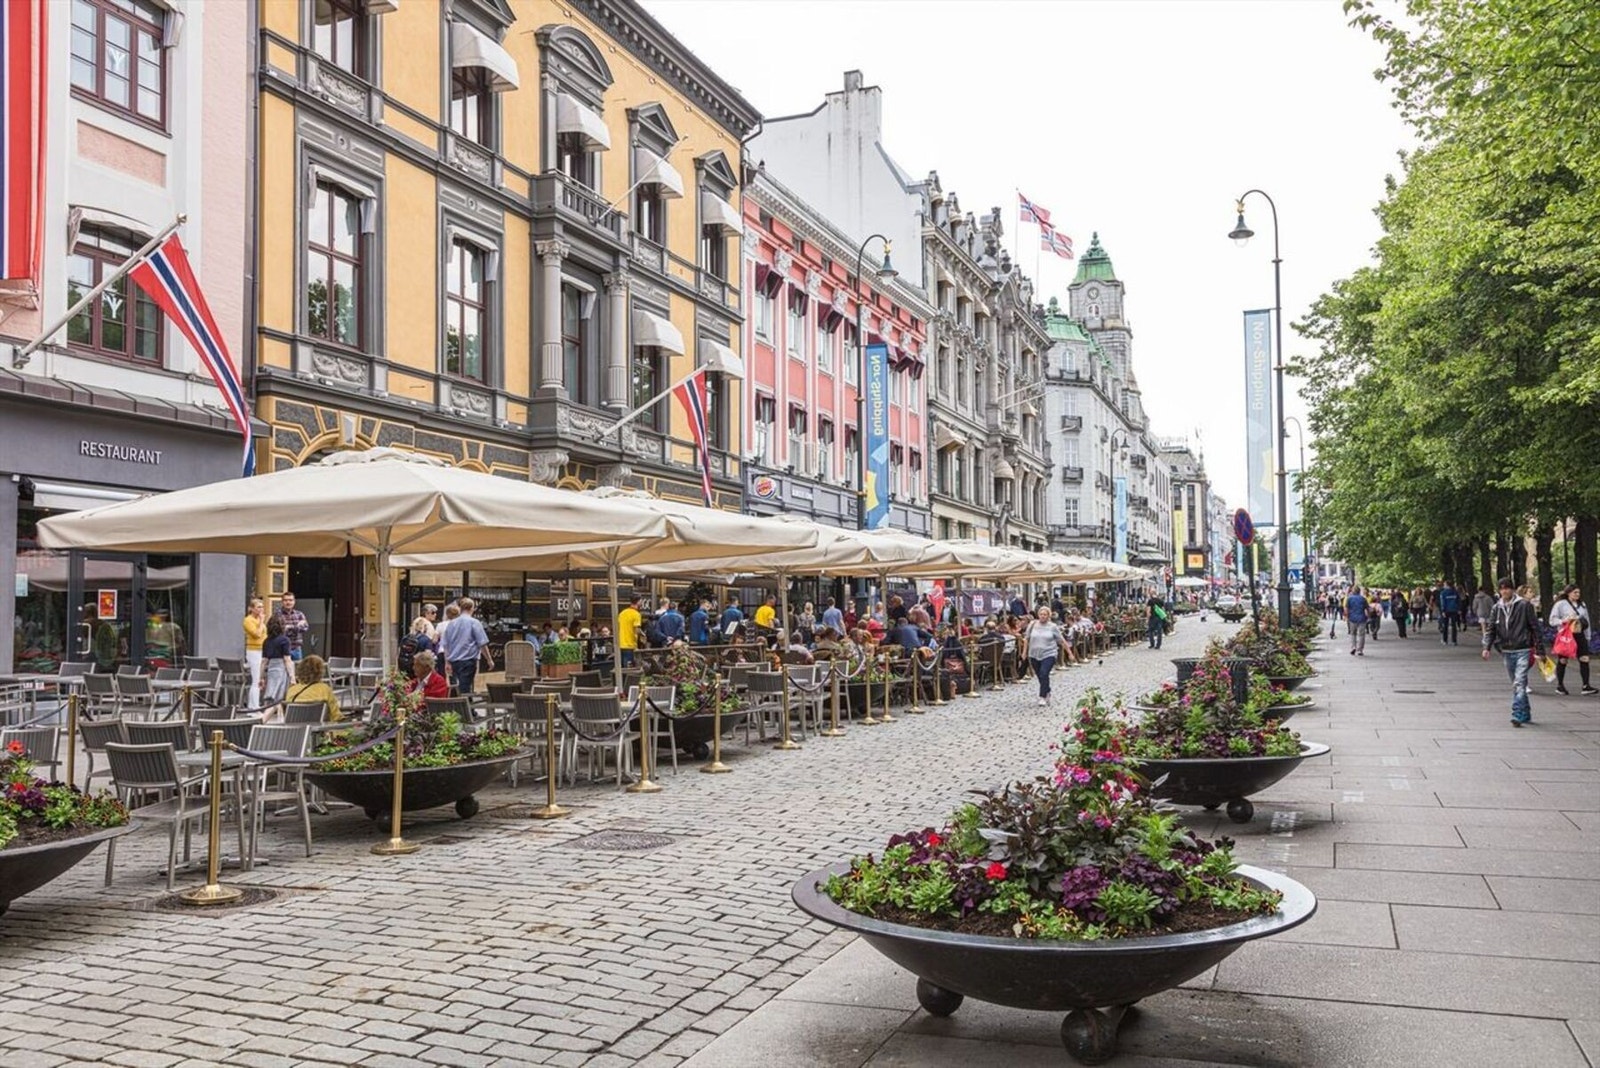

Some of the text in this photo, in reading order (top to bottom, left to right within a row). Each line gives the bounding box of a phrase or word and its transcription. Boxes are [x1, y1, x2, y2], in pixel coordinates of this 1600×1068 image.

[1252, 321, 1264, 410] Nor-Shipping
[80, 440, 162, 465] RESTAURANT
[557, 599, 581, 611] EGN
